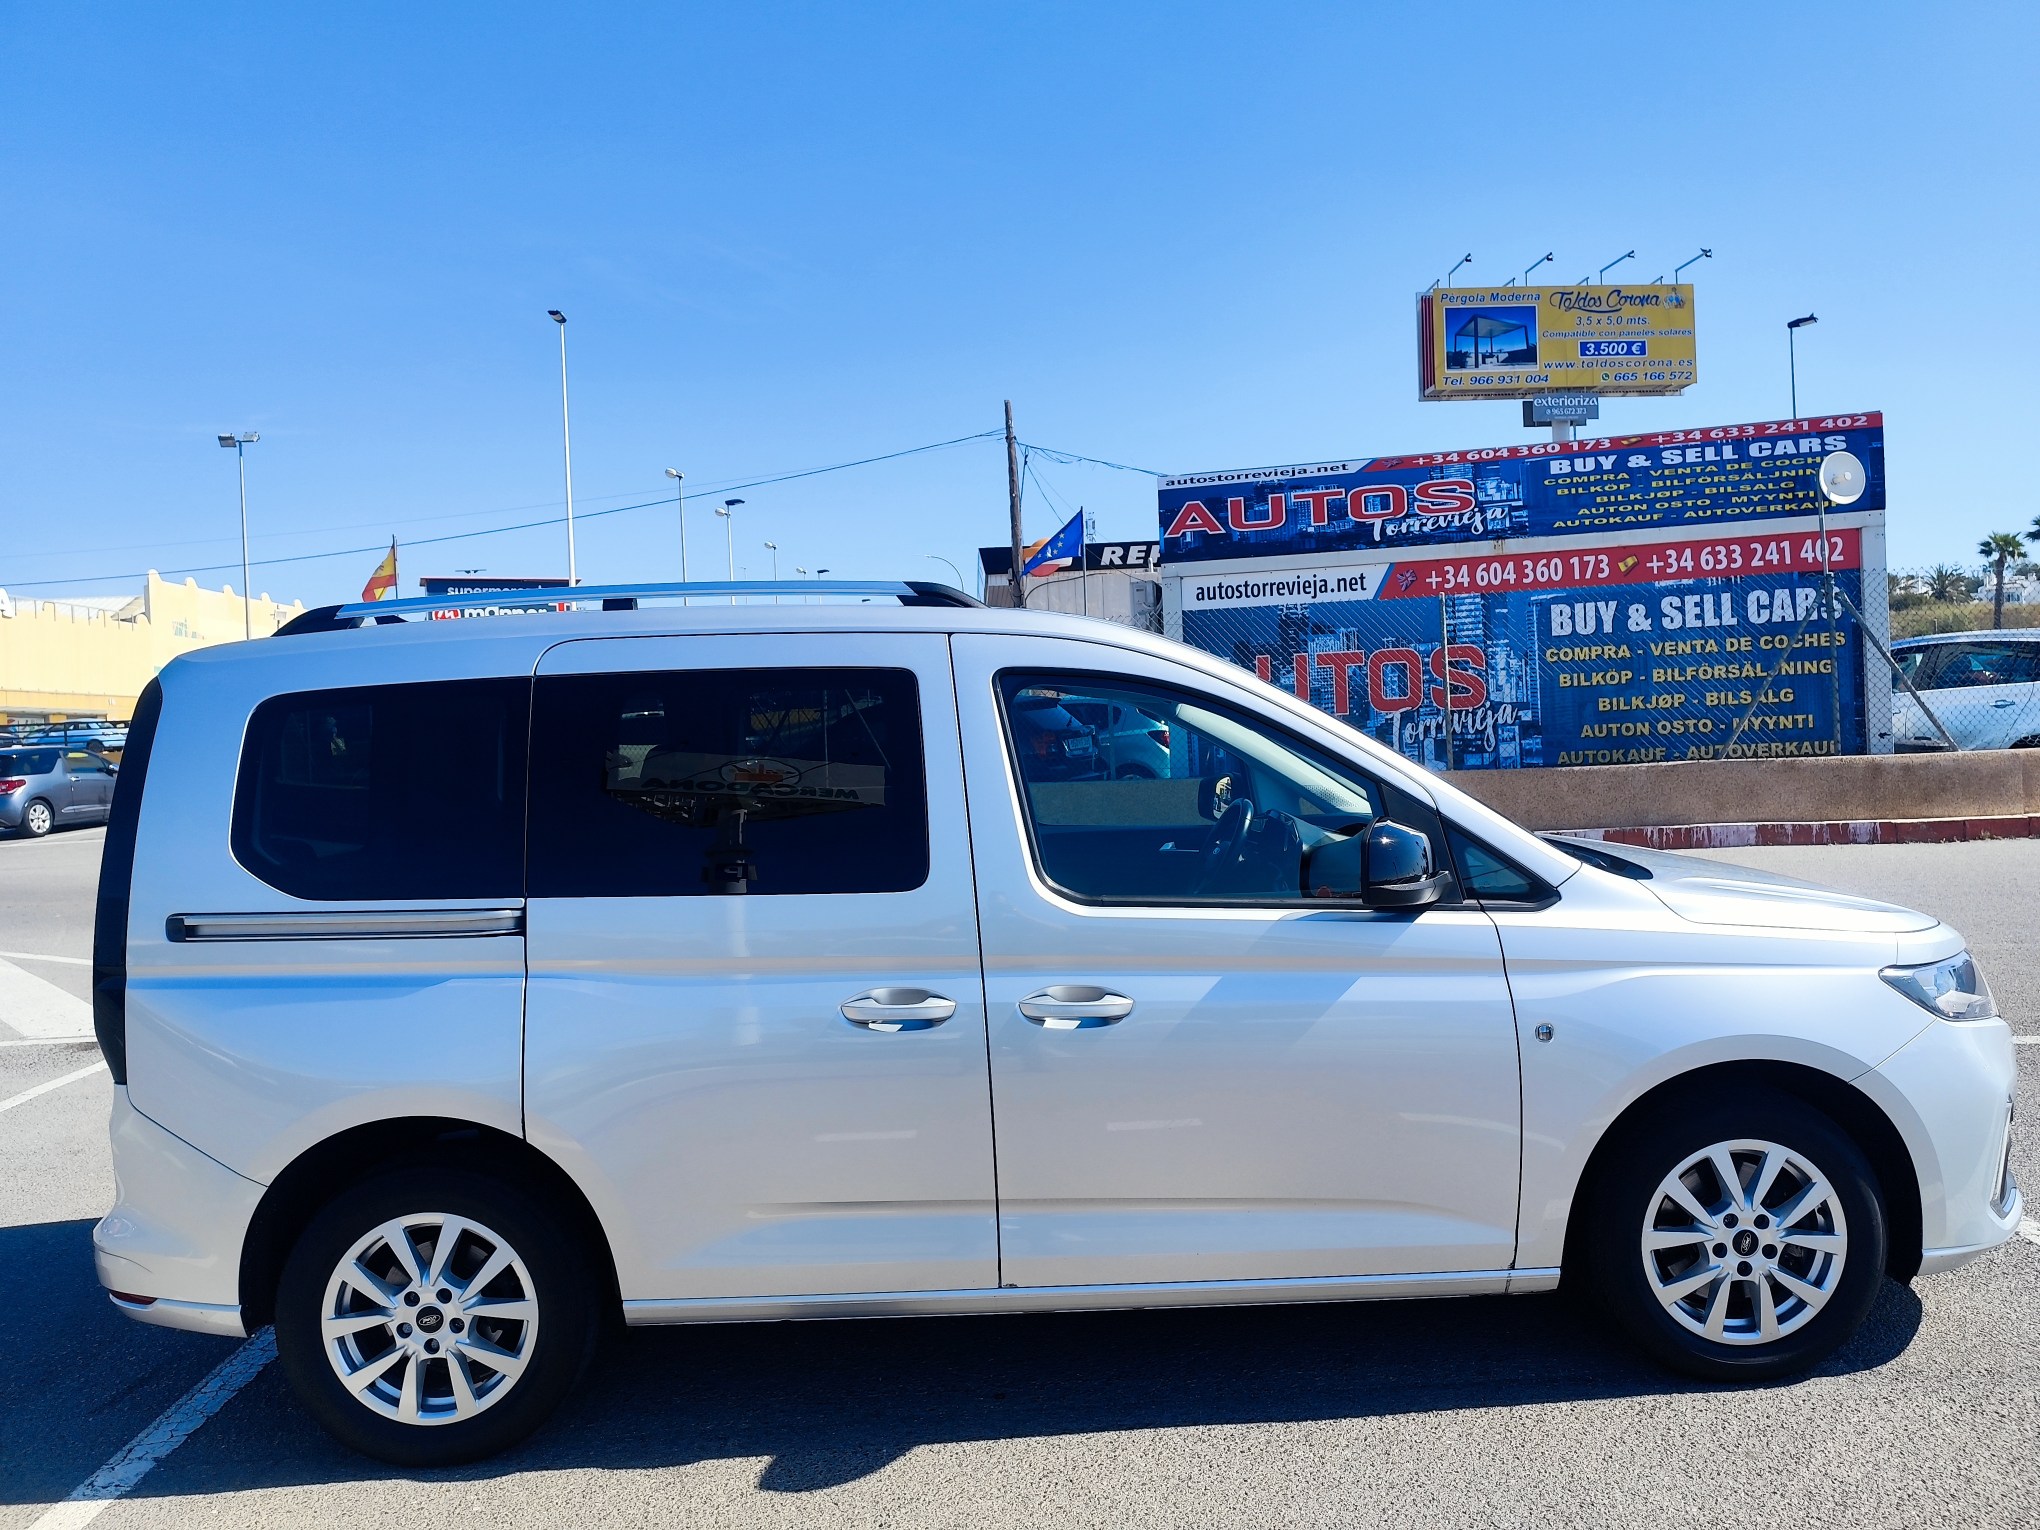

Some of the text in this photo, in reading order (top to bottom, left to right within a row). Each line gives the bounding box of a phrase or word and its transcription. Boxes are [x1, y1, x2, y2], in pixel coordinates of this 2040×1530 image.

[1489, 292, 1541, 303] Moderna
[1606, 289, 1660, 308] Corona
[1575, 316, 1650, 327] 3,5 x 5,0 mts.
[1542, 328, 1693, 339] Compatible con paneles solares
[1585, 342, 1642, 355] 3.500 €
[1543, 359, 1693, 369] www.toldoscorona.es
[1442, 374, 1549, 386] Tel. 966 931 004
[1613, 371, 1693, 382] 665 166 572
[1534, 395, 1598, 407] exterioriza
[1651, 415, 1868, 444] +34 633 241 402
[1412, 438, 1612, 466] +34 604 360 173
[1549, 435, 1847, 475] BUY & SELL CARS
[1165, 462, 1349, 487] autostorrevieja.net
[1543, 472, 1630, 486] COMPRA
[1649, 465, 1719, 477] VENTA
[1726, 461, 1754, 471] DE
[1556, 482, 1632, 496] BILKÖP
[1595, 489, 1684, 503] BILKJØP
[1704, 481, 1795, 495] BILSALG
[1164, 478, 1476, 538] AUTOS
[1577, 503, 1648, 515] AUTON
[1655, 498, 1711, 509] OSTO
[1731, 490, 1815, 503] MYYNTI
[1366, 507, 1508, 542] Torrevieja
[1552, 513, 1664, 528] AUTOKAUF
[1646, 547, 1694, 575] +34
[1700, 544, 1743, 571] 633
[1750, 540, 1792, 567] 241
[1425, 554, 1610, 590] +34 604 360 173
[1195, 572, 1367, 602] autostorrevieja.net
[1550, 600, 1618, 637] BUY
[1627, 603, 1652, 632] &
[1660, 592, 1738, 630] SELL
[1545, 644, 1631, 662] COMPRA
[1650, 638, 1719, 656] VENTA
[1725, 636, 1753, 651] DE
[1559, 668, 1633, 688] BILKÖP
[1598, 693, 1686, 712] BILKJØP
[1580, 721, 1650, 738] AUTON
[1656, 718, 1713, 735] OSTO
[1557, 746, 1666, 765] AUTOKAUF
